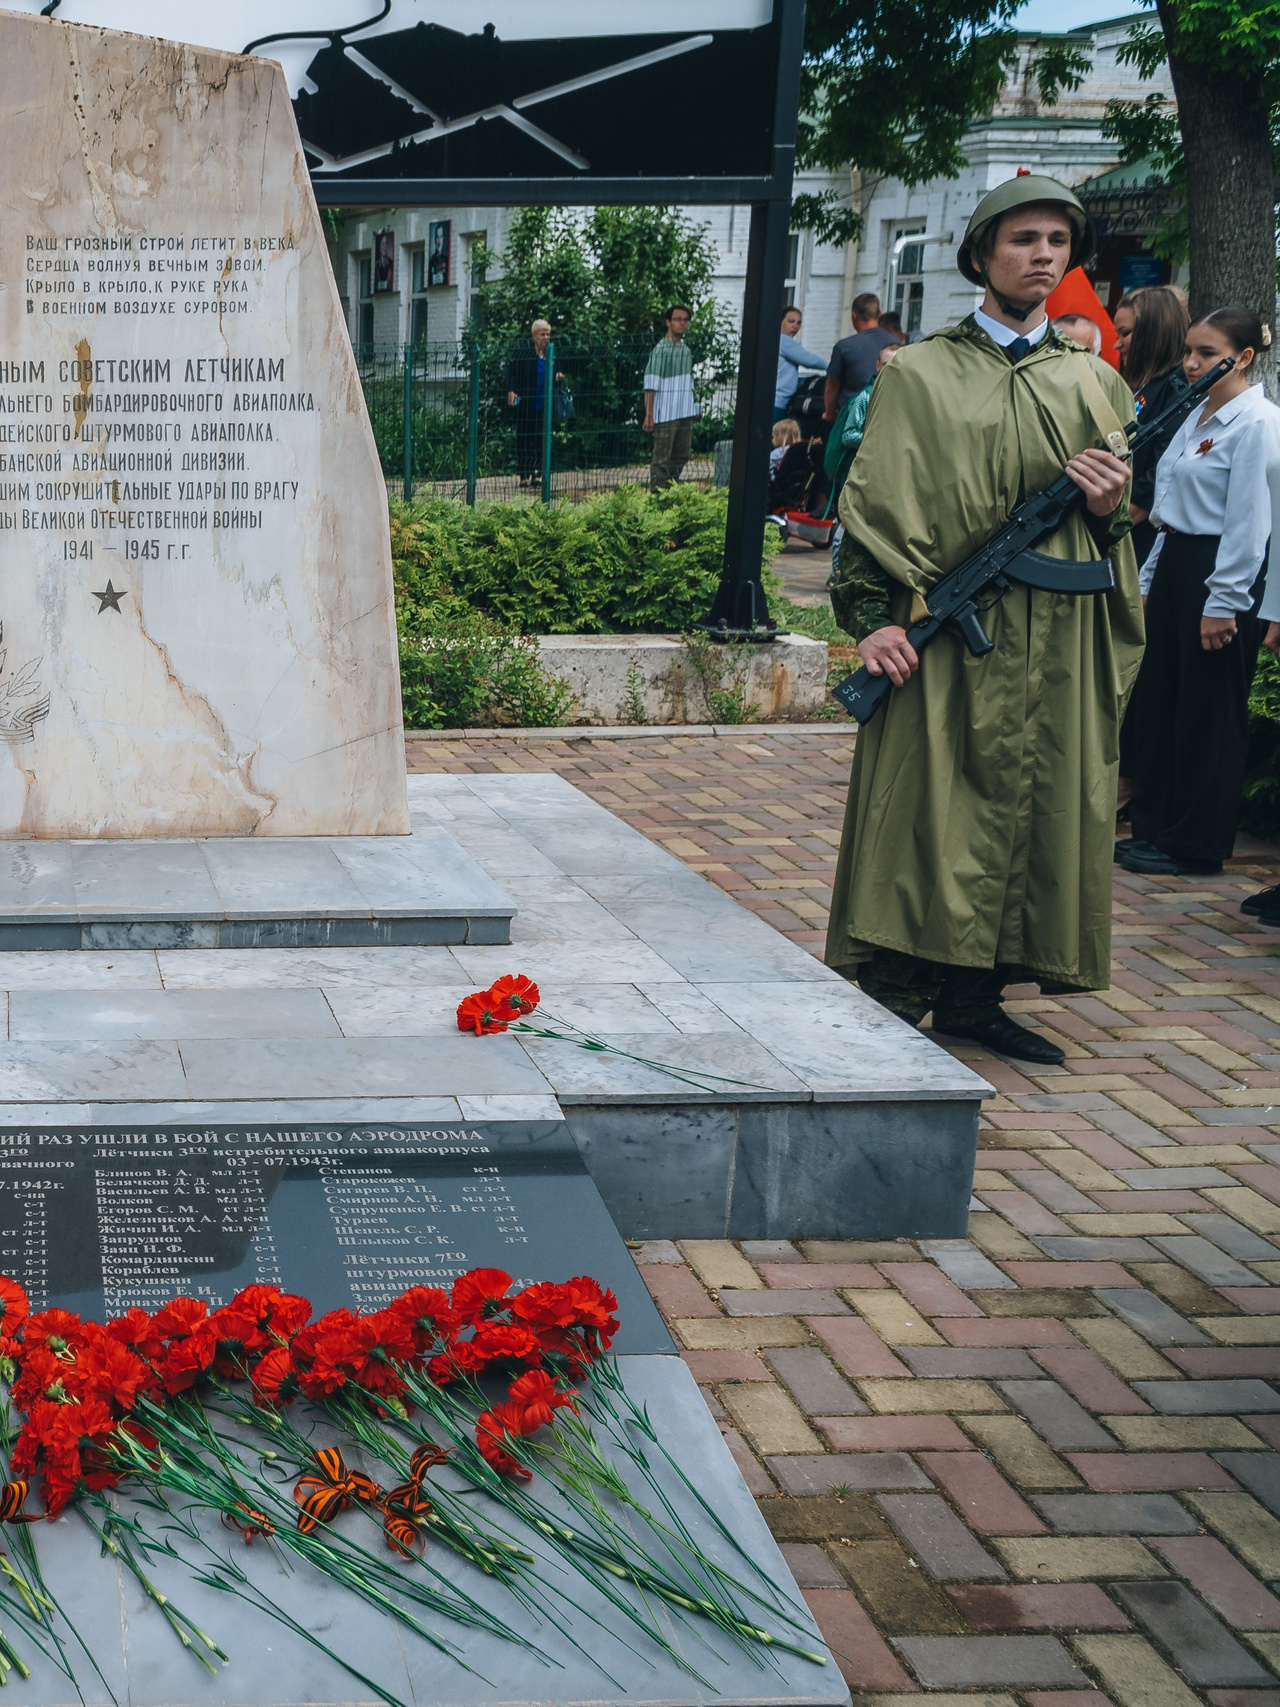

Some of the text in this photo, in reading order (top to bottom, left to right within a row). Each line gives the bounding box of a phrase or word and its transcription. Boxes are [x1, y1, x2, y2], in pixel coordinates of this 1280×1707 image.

[66, 234, 131, 250] ГРОЗНЫЙ
[140, 234, 184, 250] СТРОЙ
[192, 238, 235, 250] ЛЕТИТ
[244, 237, 250, 250] В
[88, 260, 140, 272] ВОЛНУЯ
[149, 260, 208, 272] ВЕЧНЫМ
[216, 258, 266, 271] ЗОВОМ.
[84, 282, 90, 292] В
[155, 282, 162, 292] К
[171, 281, 205, 293] РУКЕ
[214, 281, 248, 293] РУКА
[26, 300, 252, 315] В ВОЕННОМ ВОЗДУХЕ СУРОВОМ.
[59, 359, 171, 383] СОВЕТСКИМ
[184, 358, 284, 383] ЛЕТЧИКАМ
[62, 392, 222, 413] БОМБАРДИРОВОЧНОГО
[82, 423, 181, 442] ШТУРМОВОГО
[73, 448, 172, 473] АВИАЦИОННОЙ
[37, 481, 171, 501] СОКРУШИТЕЛЬНЫЕ
[179, 481, 226, 500] УДАРЫ
[231, 482, 248, 499] ПО
[254, 481, 299, 500] ВРАГУ
[22, 508, 84, 529] ВЕЛИКОЙ
[91, 508, 207, 529] ОТЕЧЕСТВЕННОЙ
[213, 507, 262, 529] ВОЙНЫ
[64, 541, 93, 560] 1941
[125, 540, 160, 560] 1945
[38, 1135, 73, 1145] РАЗ
[79, 1134, 148, 1144] УШЛИ
[155, 1134, 168, 1143] В
[173, 1131, 218, 1143] БОЙ
[225, 1132, 239, 1143] С
[245, 1131, 343, 1143] НАШЕГО
[349, 1130, 484, 1142] АЭРОДРОМА
[93, 1149, 173, 1158] Лётчики
[213, 1146, 368, 1157] истребительного
[374, 1146, 490, 1155] авиакорпуса
[227, 1156, 343, 1166] 03 07.1943г.
